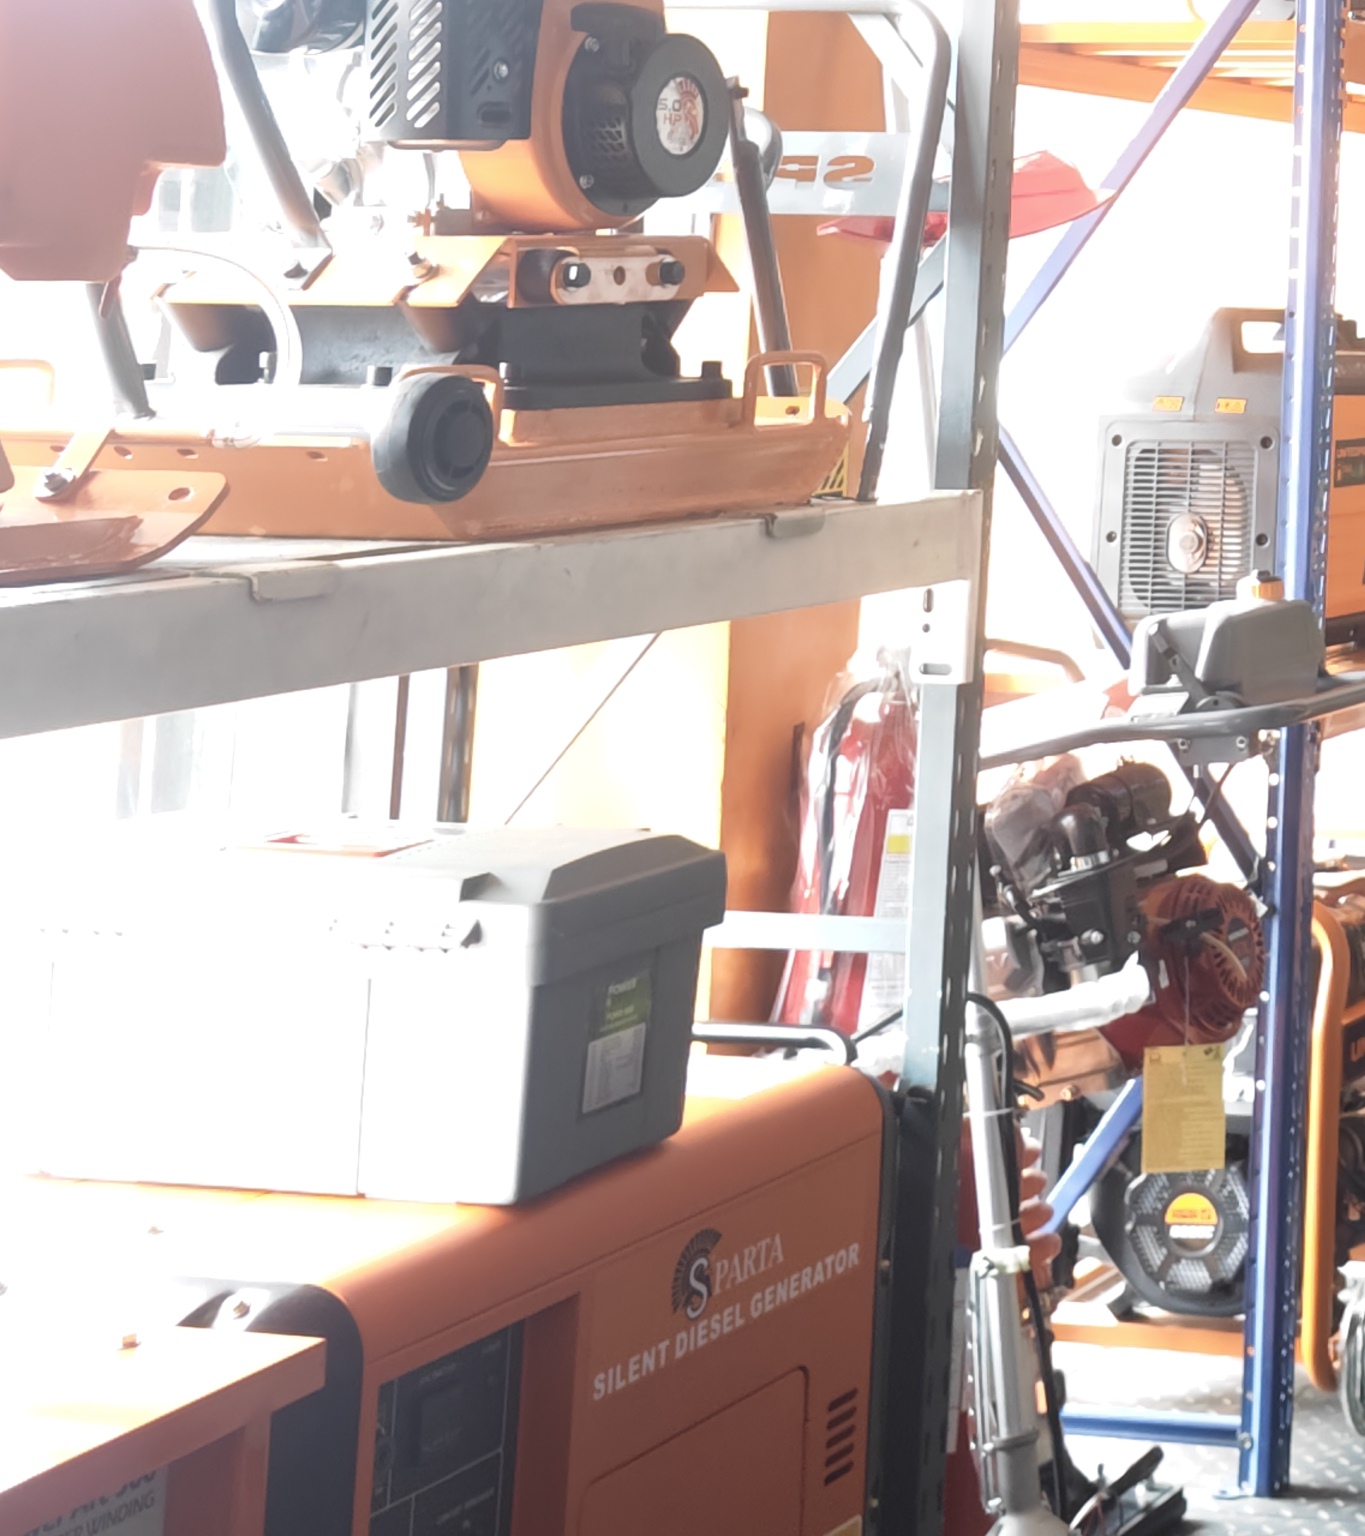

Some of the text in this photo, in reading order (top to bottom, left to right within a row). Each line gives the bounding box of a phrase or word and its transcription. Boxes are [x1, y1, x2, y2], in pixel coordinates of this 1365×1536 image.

[593, 1242, 860, 1401] SILENT DIESEL GENERATOR
[87, 1492, 155, 1535] WINDING
